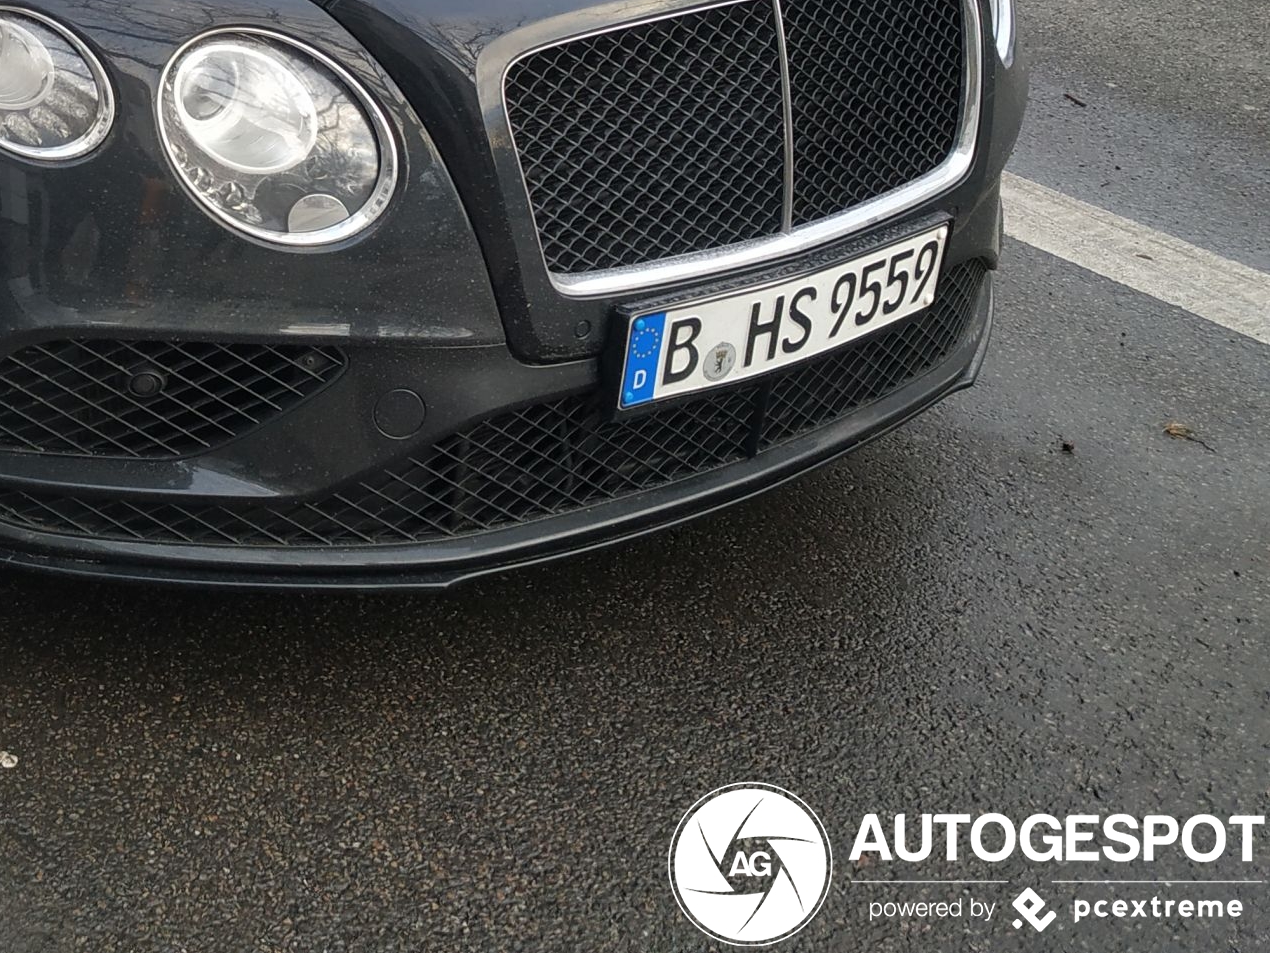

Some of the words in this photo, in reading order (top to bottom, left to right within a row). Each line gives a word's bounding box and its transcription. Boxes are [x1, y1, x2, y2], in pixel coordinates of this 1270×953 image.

[632, 369, 648, 391] D
[661, 316, 703, 387] B
[743, 286, 818, 369] HS
[828, 240, 939, 339] 9559
